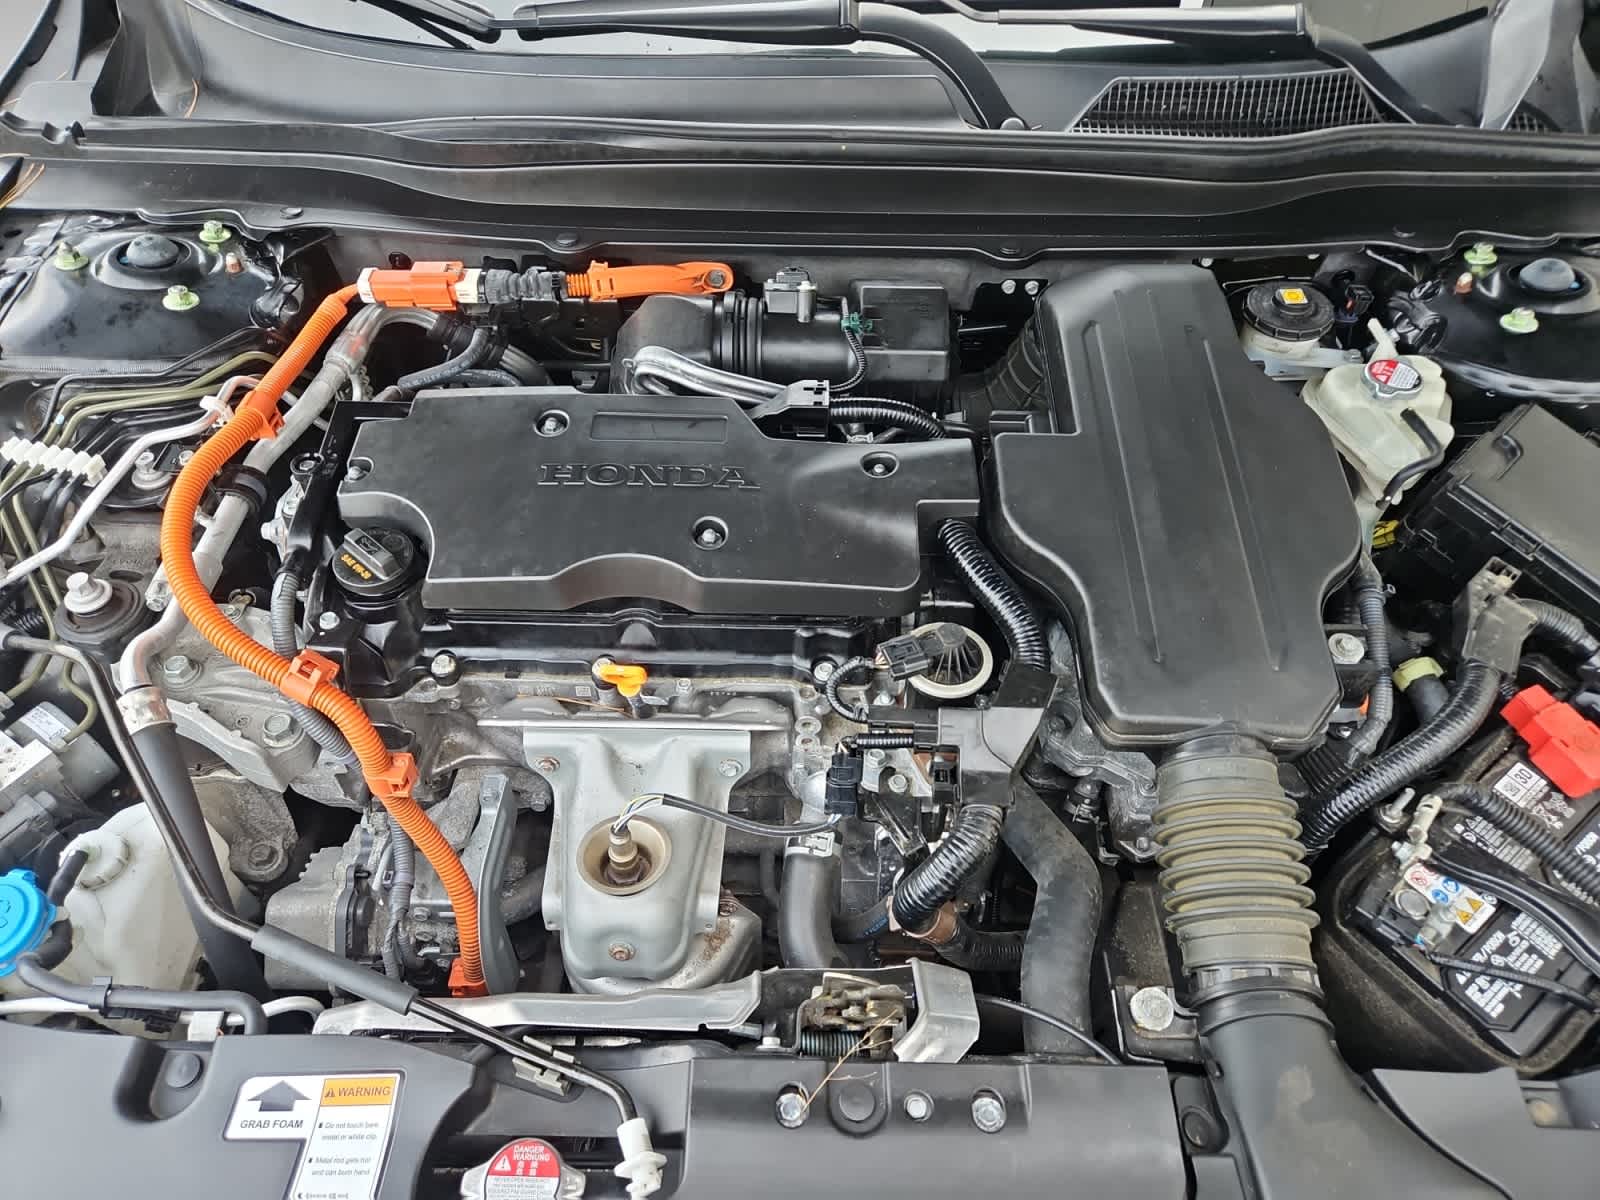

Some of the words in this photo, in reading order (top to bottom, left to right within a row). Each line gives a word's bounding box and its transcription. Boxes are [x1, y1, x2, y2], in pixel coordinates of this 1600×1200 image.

[537, 463, 760, 489] HONDA
[338, 1086, 391, 1098] WARNING
[240, 1119, 271, 1129] GRAB
[272, 1119, 304, 1129] FOAM
[513, 1145, 545, 1153] DANGER
